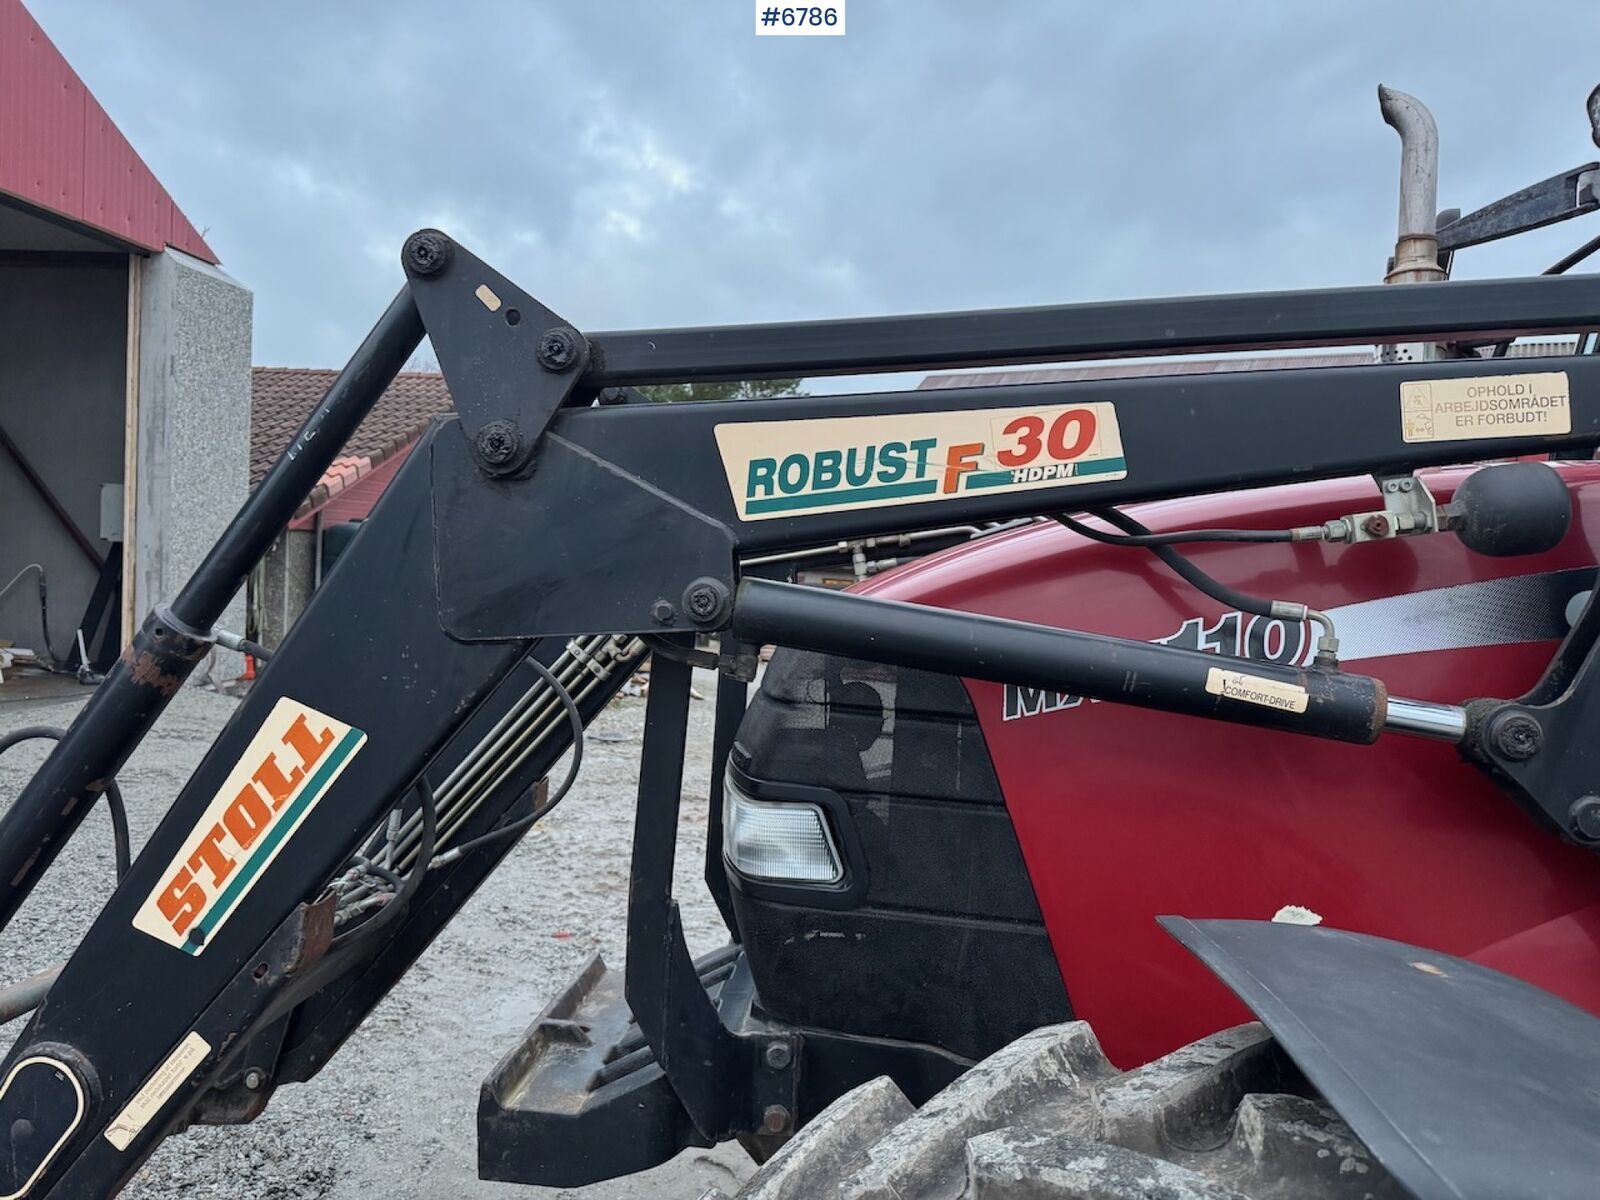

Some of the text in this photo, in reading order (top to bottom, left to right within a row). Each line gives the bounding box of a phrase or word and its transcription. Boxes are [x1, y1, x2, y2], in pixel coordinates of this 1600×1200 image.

[1466, 384, 1525, 398] OPHOLD
[1434, 395, 1567, 414] ARBEJDSOMRÅDET
[1455, 411, 1548, 427] ER FORBUDT!
[746, 409, 1096, 498] ROBUST F 30
[1012, 463, 1075, 483] HDPM
[1224, 685, 1297, 710] COMFORT-DRIVE
[156, 713, 336, 937] STOLL
